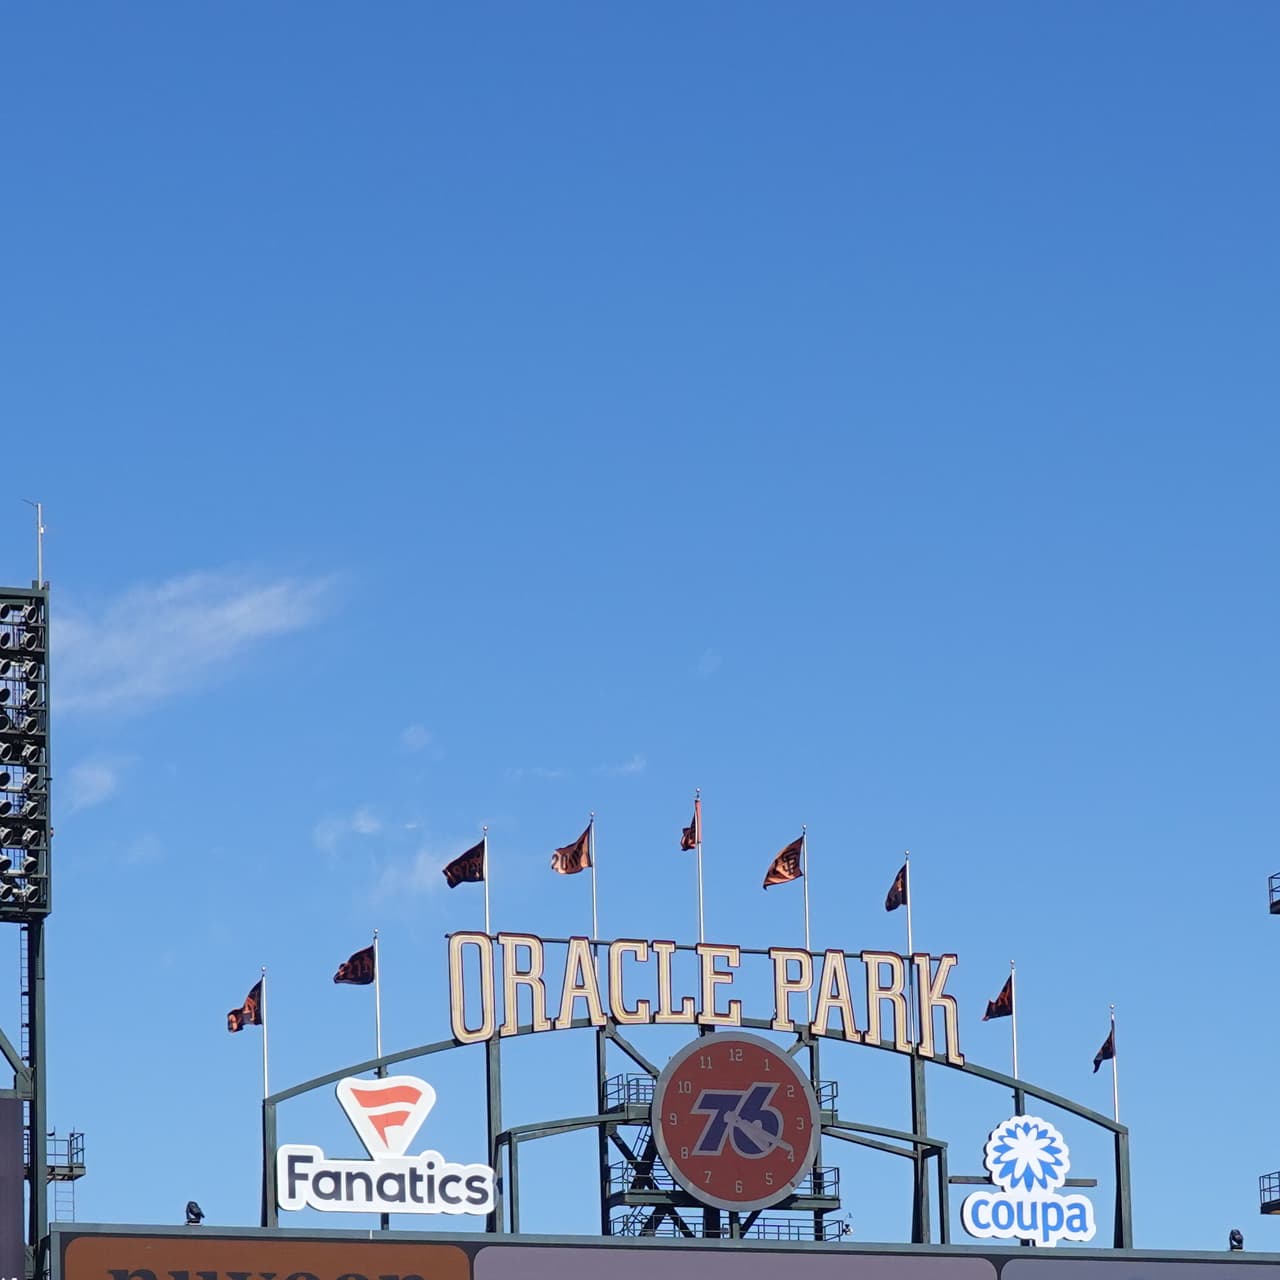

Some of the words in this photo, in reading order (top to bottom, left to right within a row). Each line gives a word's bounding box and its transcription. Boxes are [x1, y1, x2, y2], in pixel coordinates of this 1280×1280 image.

[448, 930, 741, 1044] ORACLE
[769, 946, 964, 1066] PARK
[729, 1048, 743, 1061] 12
[700, 1056, 712, 1069] 11
[764, 1059, 770, 1071] 1
[678, 1080, 691, 1094] 10
[786, 1084, 794, 1097] 2
[669, 1113, 677, 1125] 9
[690, 1082, 784, 1159] 76
[796, 1117, 804, 1130] 3
[681, 1146, 688, 1159] 8
[787, 1148, 795, 1162] 4
[287, 1154, 489, 1205] Fanatics
[704, 1171, 712, 1183] 7
[765, 1172, 773, 1185] 5
[735, 1180, 743, 1193] 6
[971, 1198, 1089, 1240] coupa
